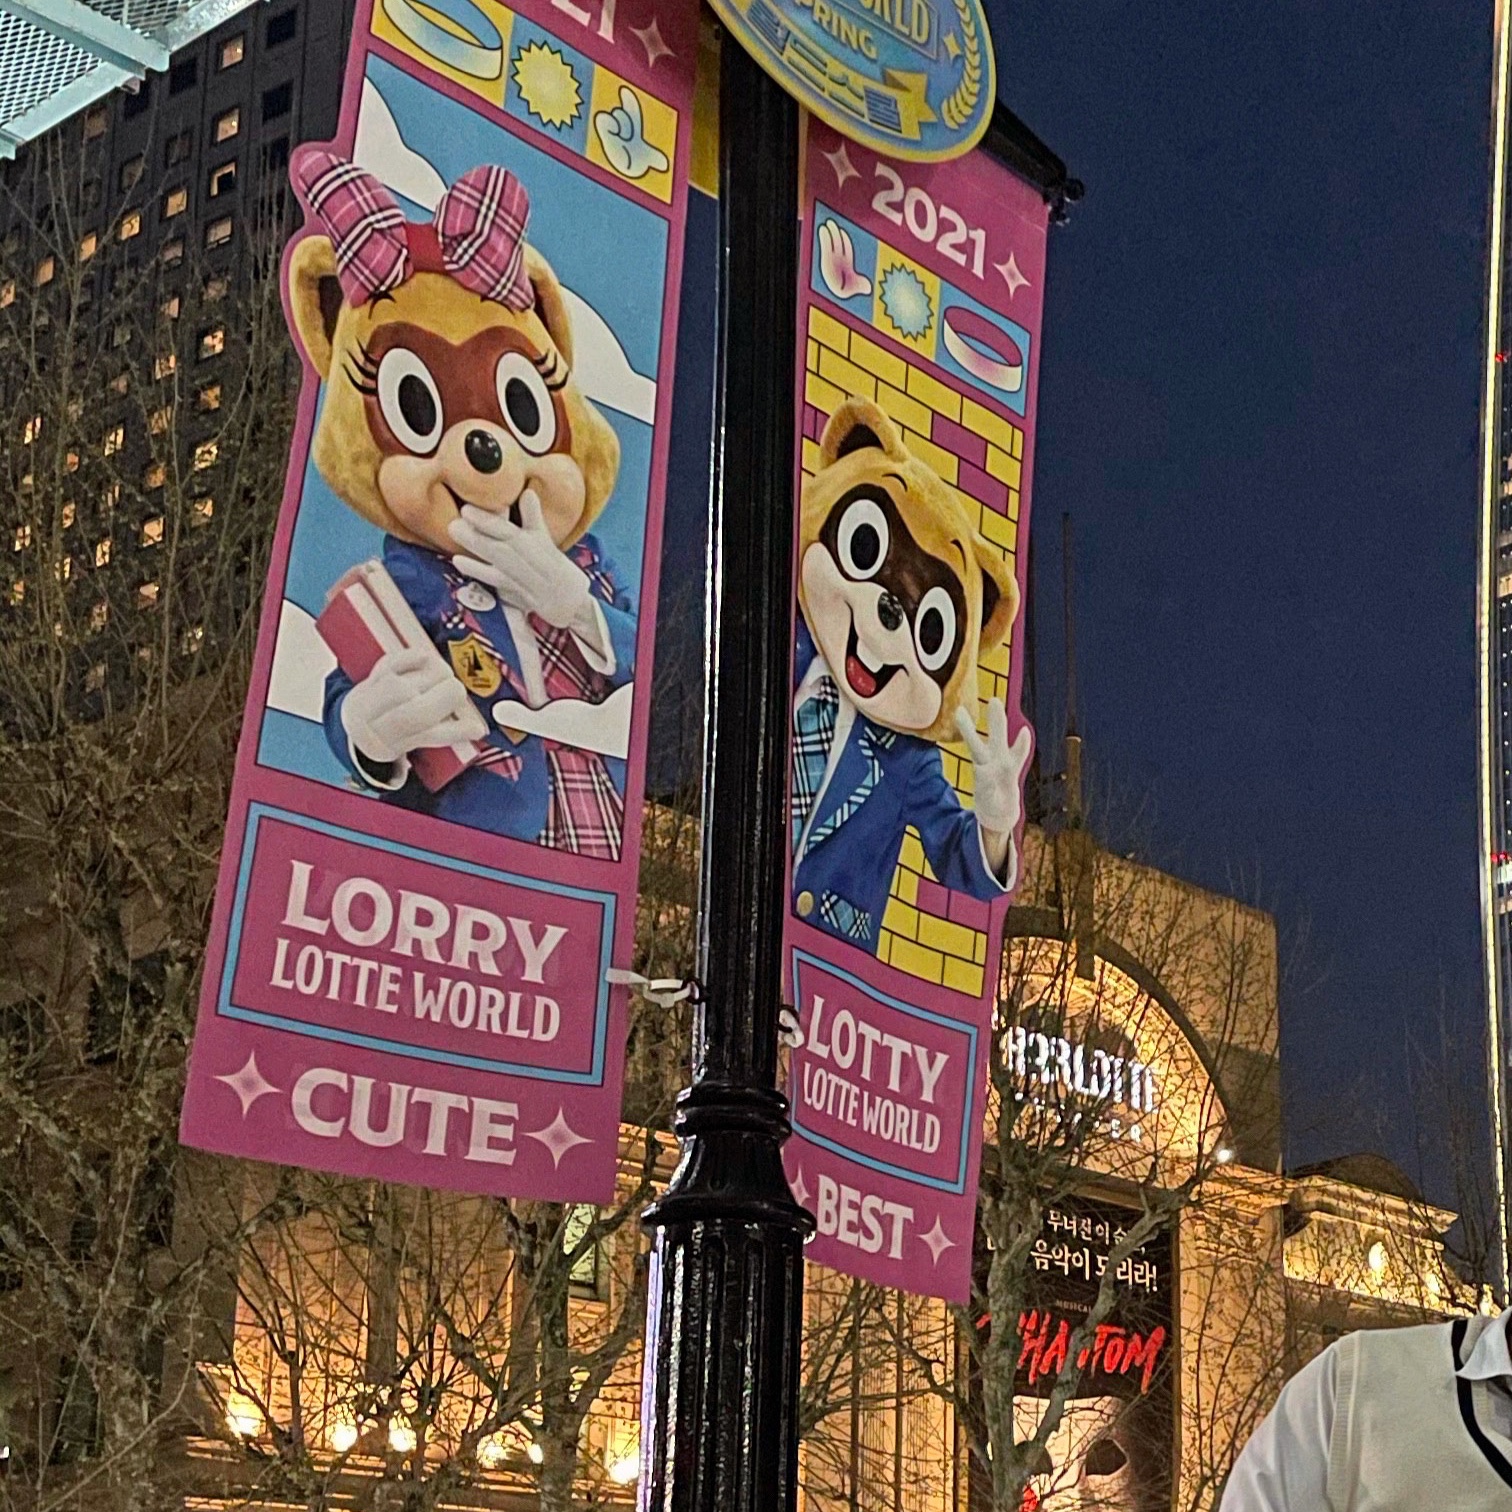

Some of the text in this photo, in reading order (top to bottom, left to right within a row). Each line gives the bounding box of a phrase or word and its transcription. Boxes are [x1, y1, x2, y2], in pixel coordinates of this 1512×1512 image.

[871, 162, 986, 280] 2021
[281, 859, 569, 984] LORRY
[269, 937, 561, 1042] LOTTE WORLD
[806, 994, 949, 1104] LOTTY
[291, 1067, 519, 1166] CUTE
[803, 1062, 860, 1127] LOTTE
[863, 1091, 941, 1154] WORLD
[817, 1174, 914, 1260] BEST
[1030, 1239, 1090, 1281] 음악이
